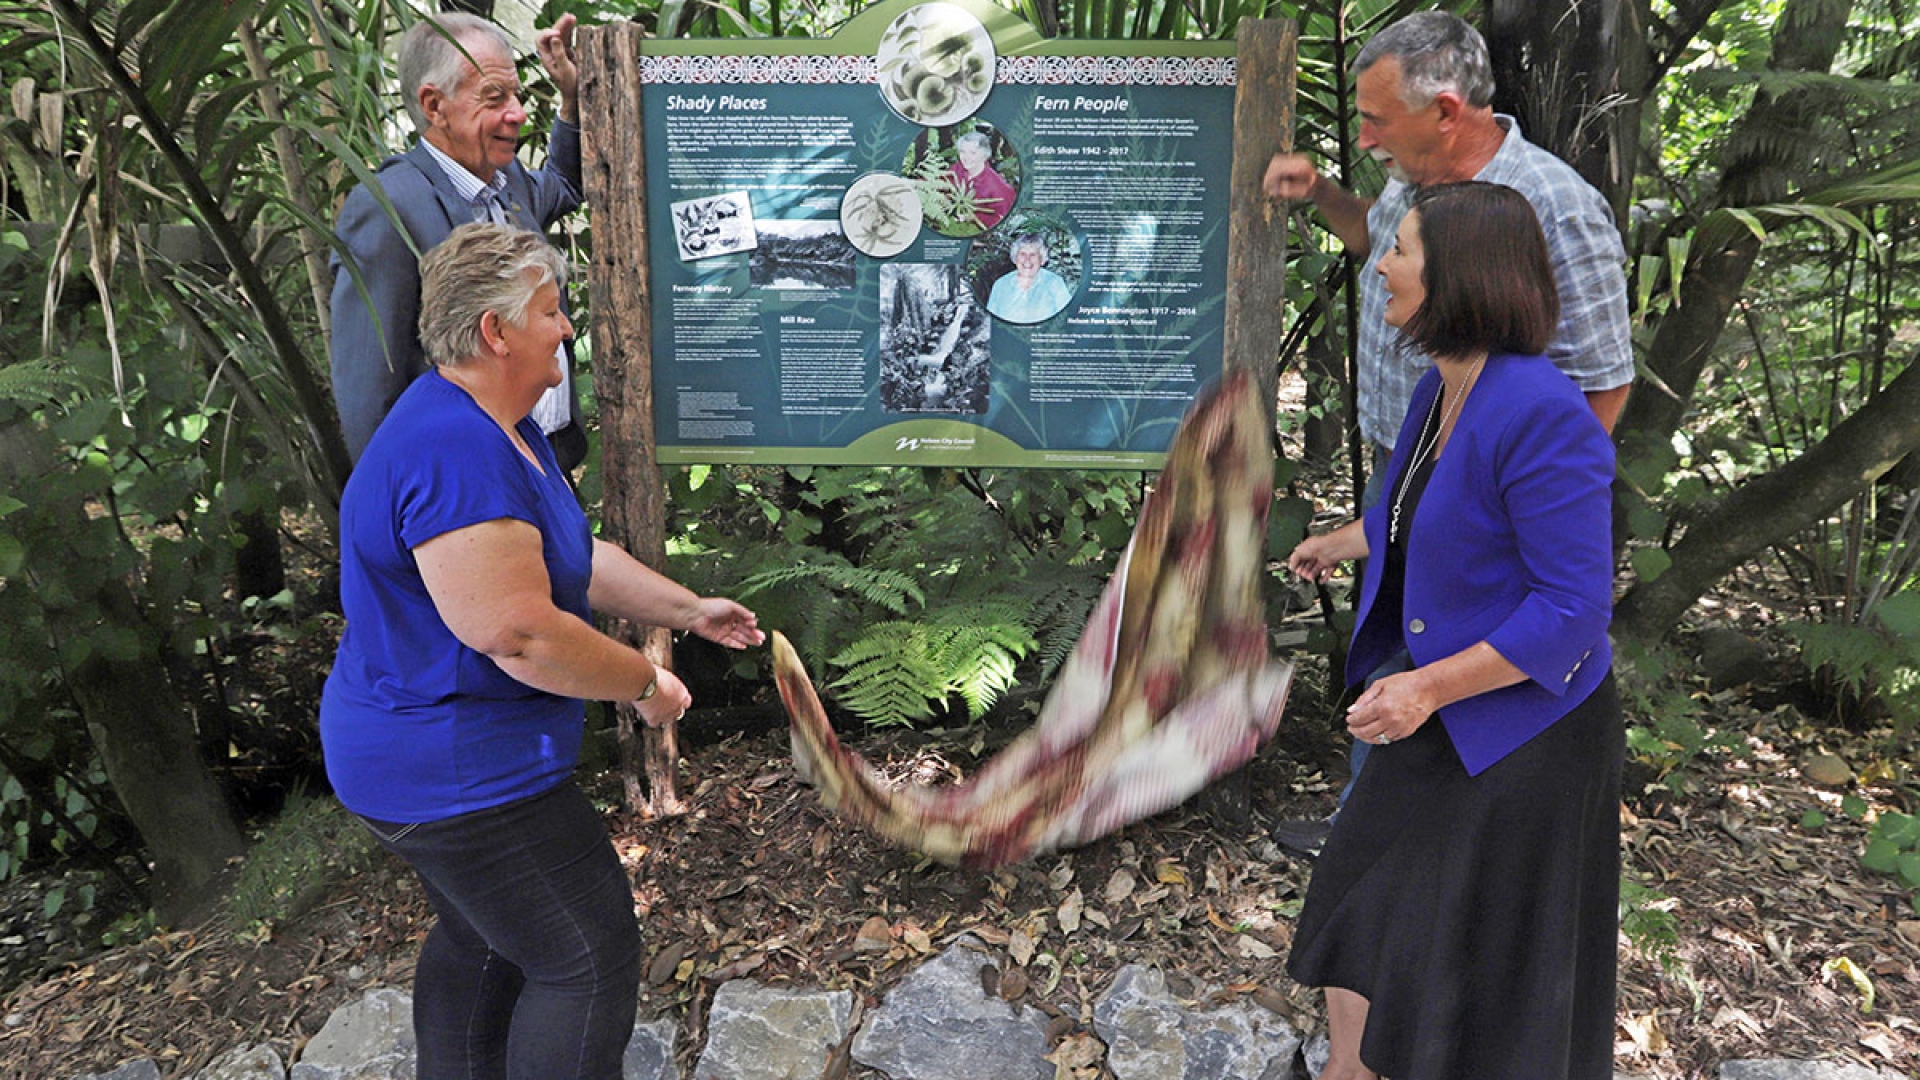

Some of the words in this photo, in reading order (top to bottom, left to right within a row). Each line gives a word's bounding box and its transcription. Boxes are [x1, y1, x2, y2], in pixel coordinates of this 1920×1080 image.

[666, 94, 715, 113] Shady
[719, 94, 767, 110] Places
[1035, 95, 1069, 110] Fern
[1073, 95, 1128, 114] People
[1035, 146, 1056, 155] Edith
[1057, 146, 1079, 155] Shaw
[1082, 146, 1100, 155] 1942
[672, 285, 701, 294] Fernery
[703, 285, 733, 294] History
[796, 315, 815, 324] Race
